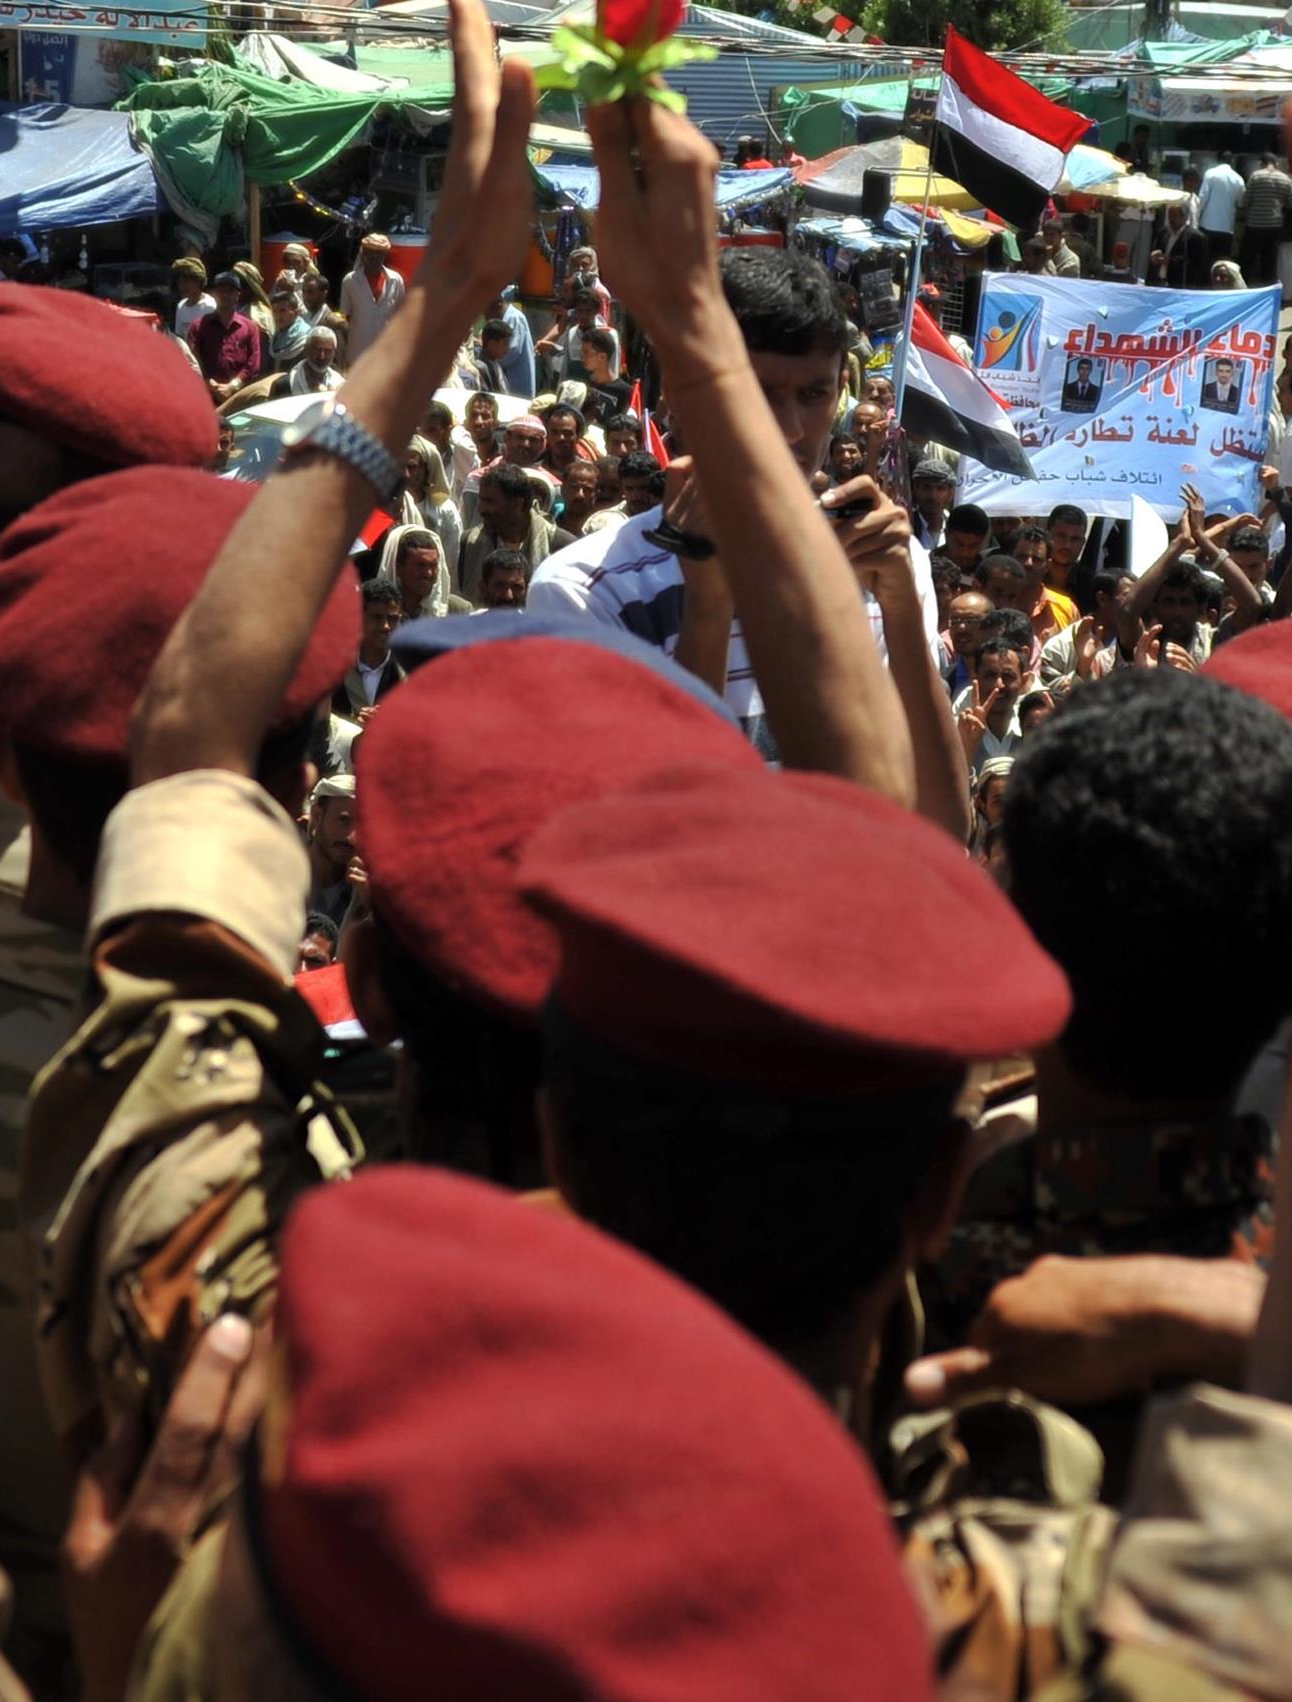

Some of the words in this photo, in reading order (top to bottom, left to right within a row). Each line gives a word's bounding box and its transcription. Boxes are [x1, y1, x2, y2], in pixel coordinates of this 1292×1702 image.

[1064, 319, 1204, 359] الشهداء
[1207, 323, 1277, 359] دماء
[1147, 415, 1200, 446] لعنة
[1066, 470, 1107, 486] شباب
